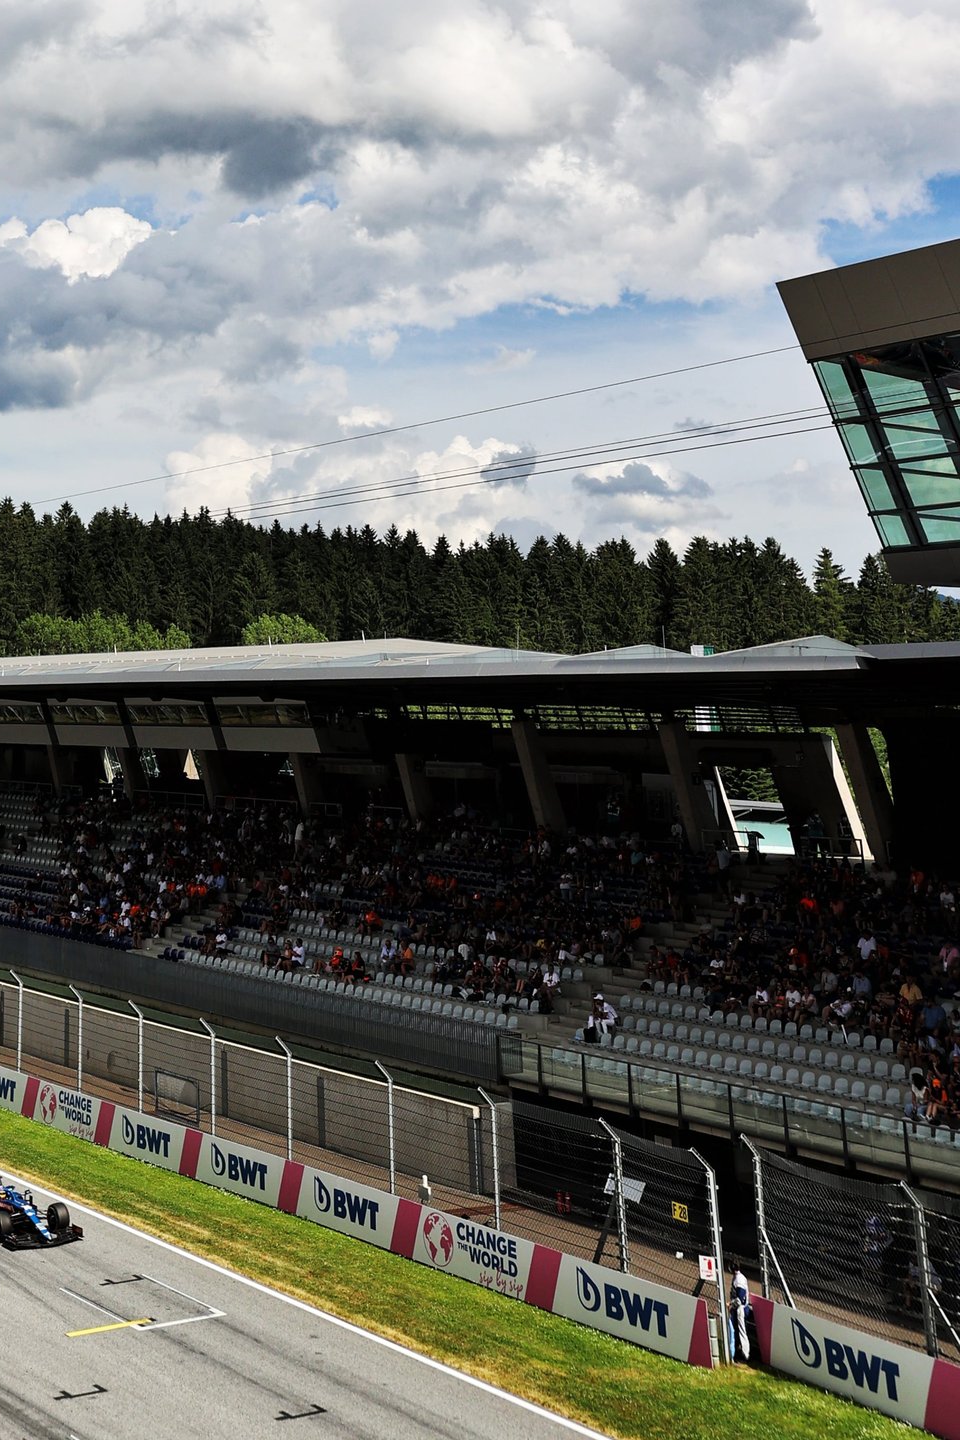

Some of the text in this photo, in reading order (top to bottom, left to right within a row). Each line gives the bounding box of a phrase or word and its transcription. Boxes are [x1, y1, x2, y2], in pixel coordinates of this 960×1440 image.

[58, 1090, 92, 1114] CHANGE
[64, 1107, 92, 1126] WORLD
[136, 1124, 171, 1158] BWT
[227, 1153, 268, 1191] BWT
[333, 1188, 380, 1231] BWT
[679, 1205, 687, 1220] 28
[456, 1222, 517, 1260] CHANGE
[456, 1241, 518, 1278] THE WORLD
[479, 1267, 524, 1300] sip by sip
[604, 1282, 669, 1338] BWT
[823, 1336, 901, 1402] BWT
